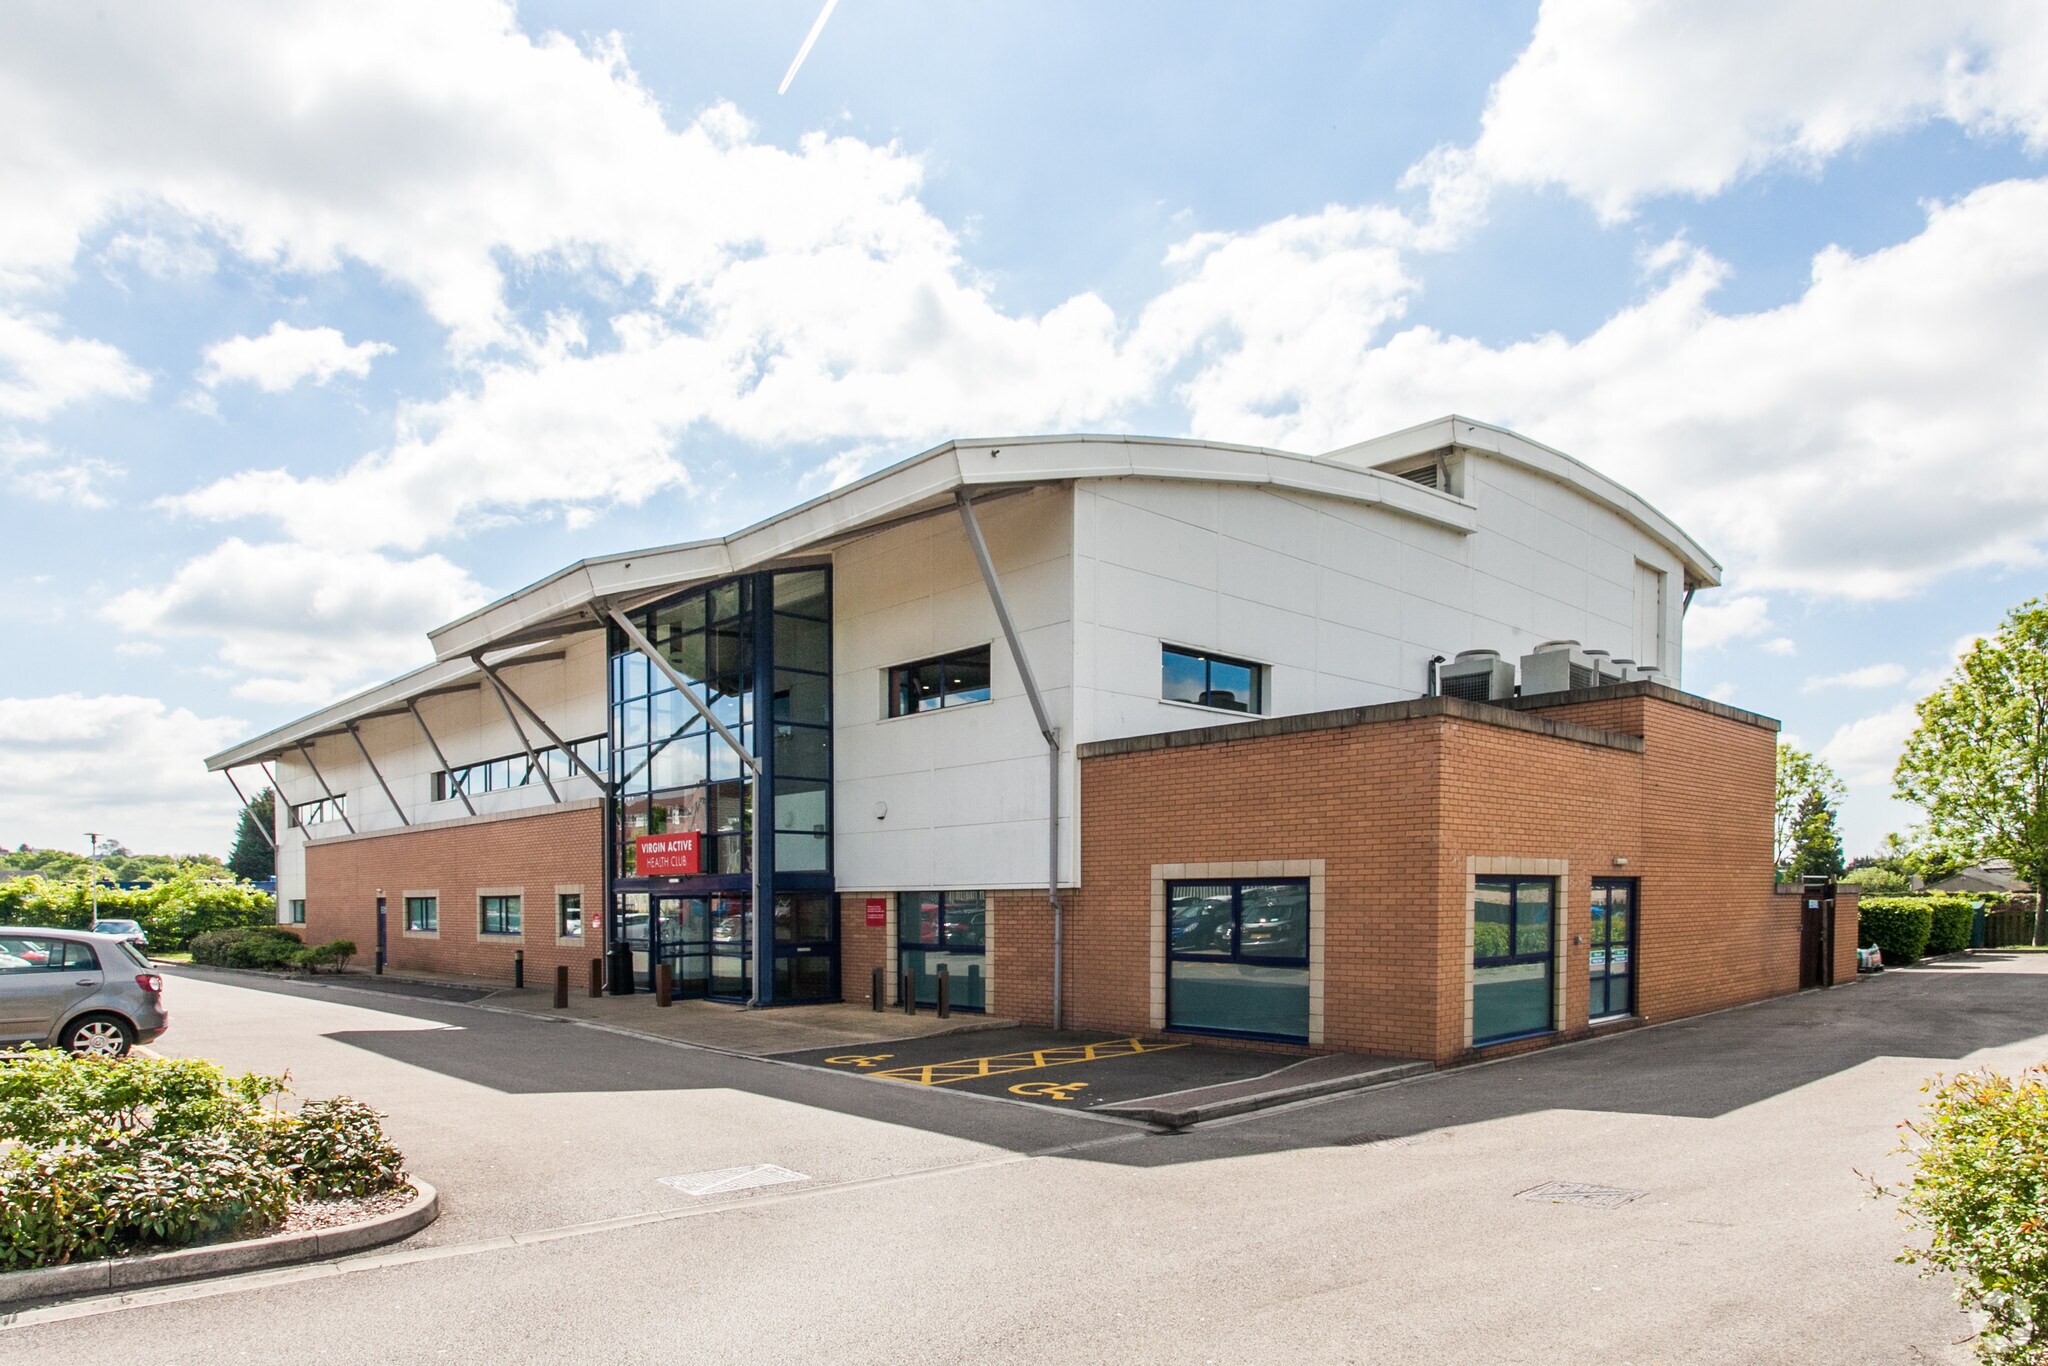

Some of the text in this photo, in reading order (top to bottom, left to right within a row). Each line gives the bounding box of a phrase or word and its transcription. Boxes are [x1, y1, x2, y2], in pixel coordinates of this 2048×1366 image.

[641, 840, 692, 854] VIRGIN ACTIVE
[647, 856, 687, 868] HEALTH CLUB
